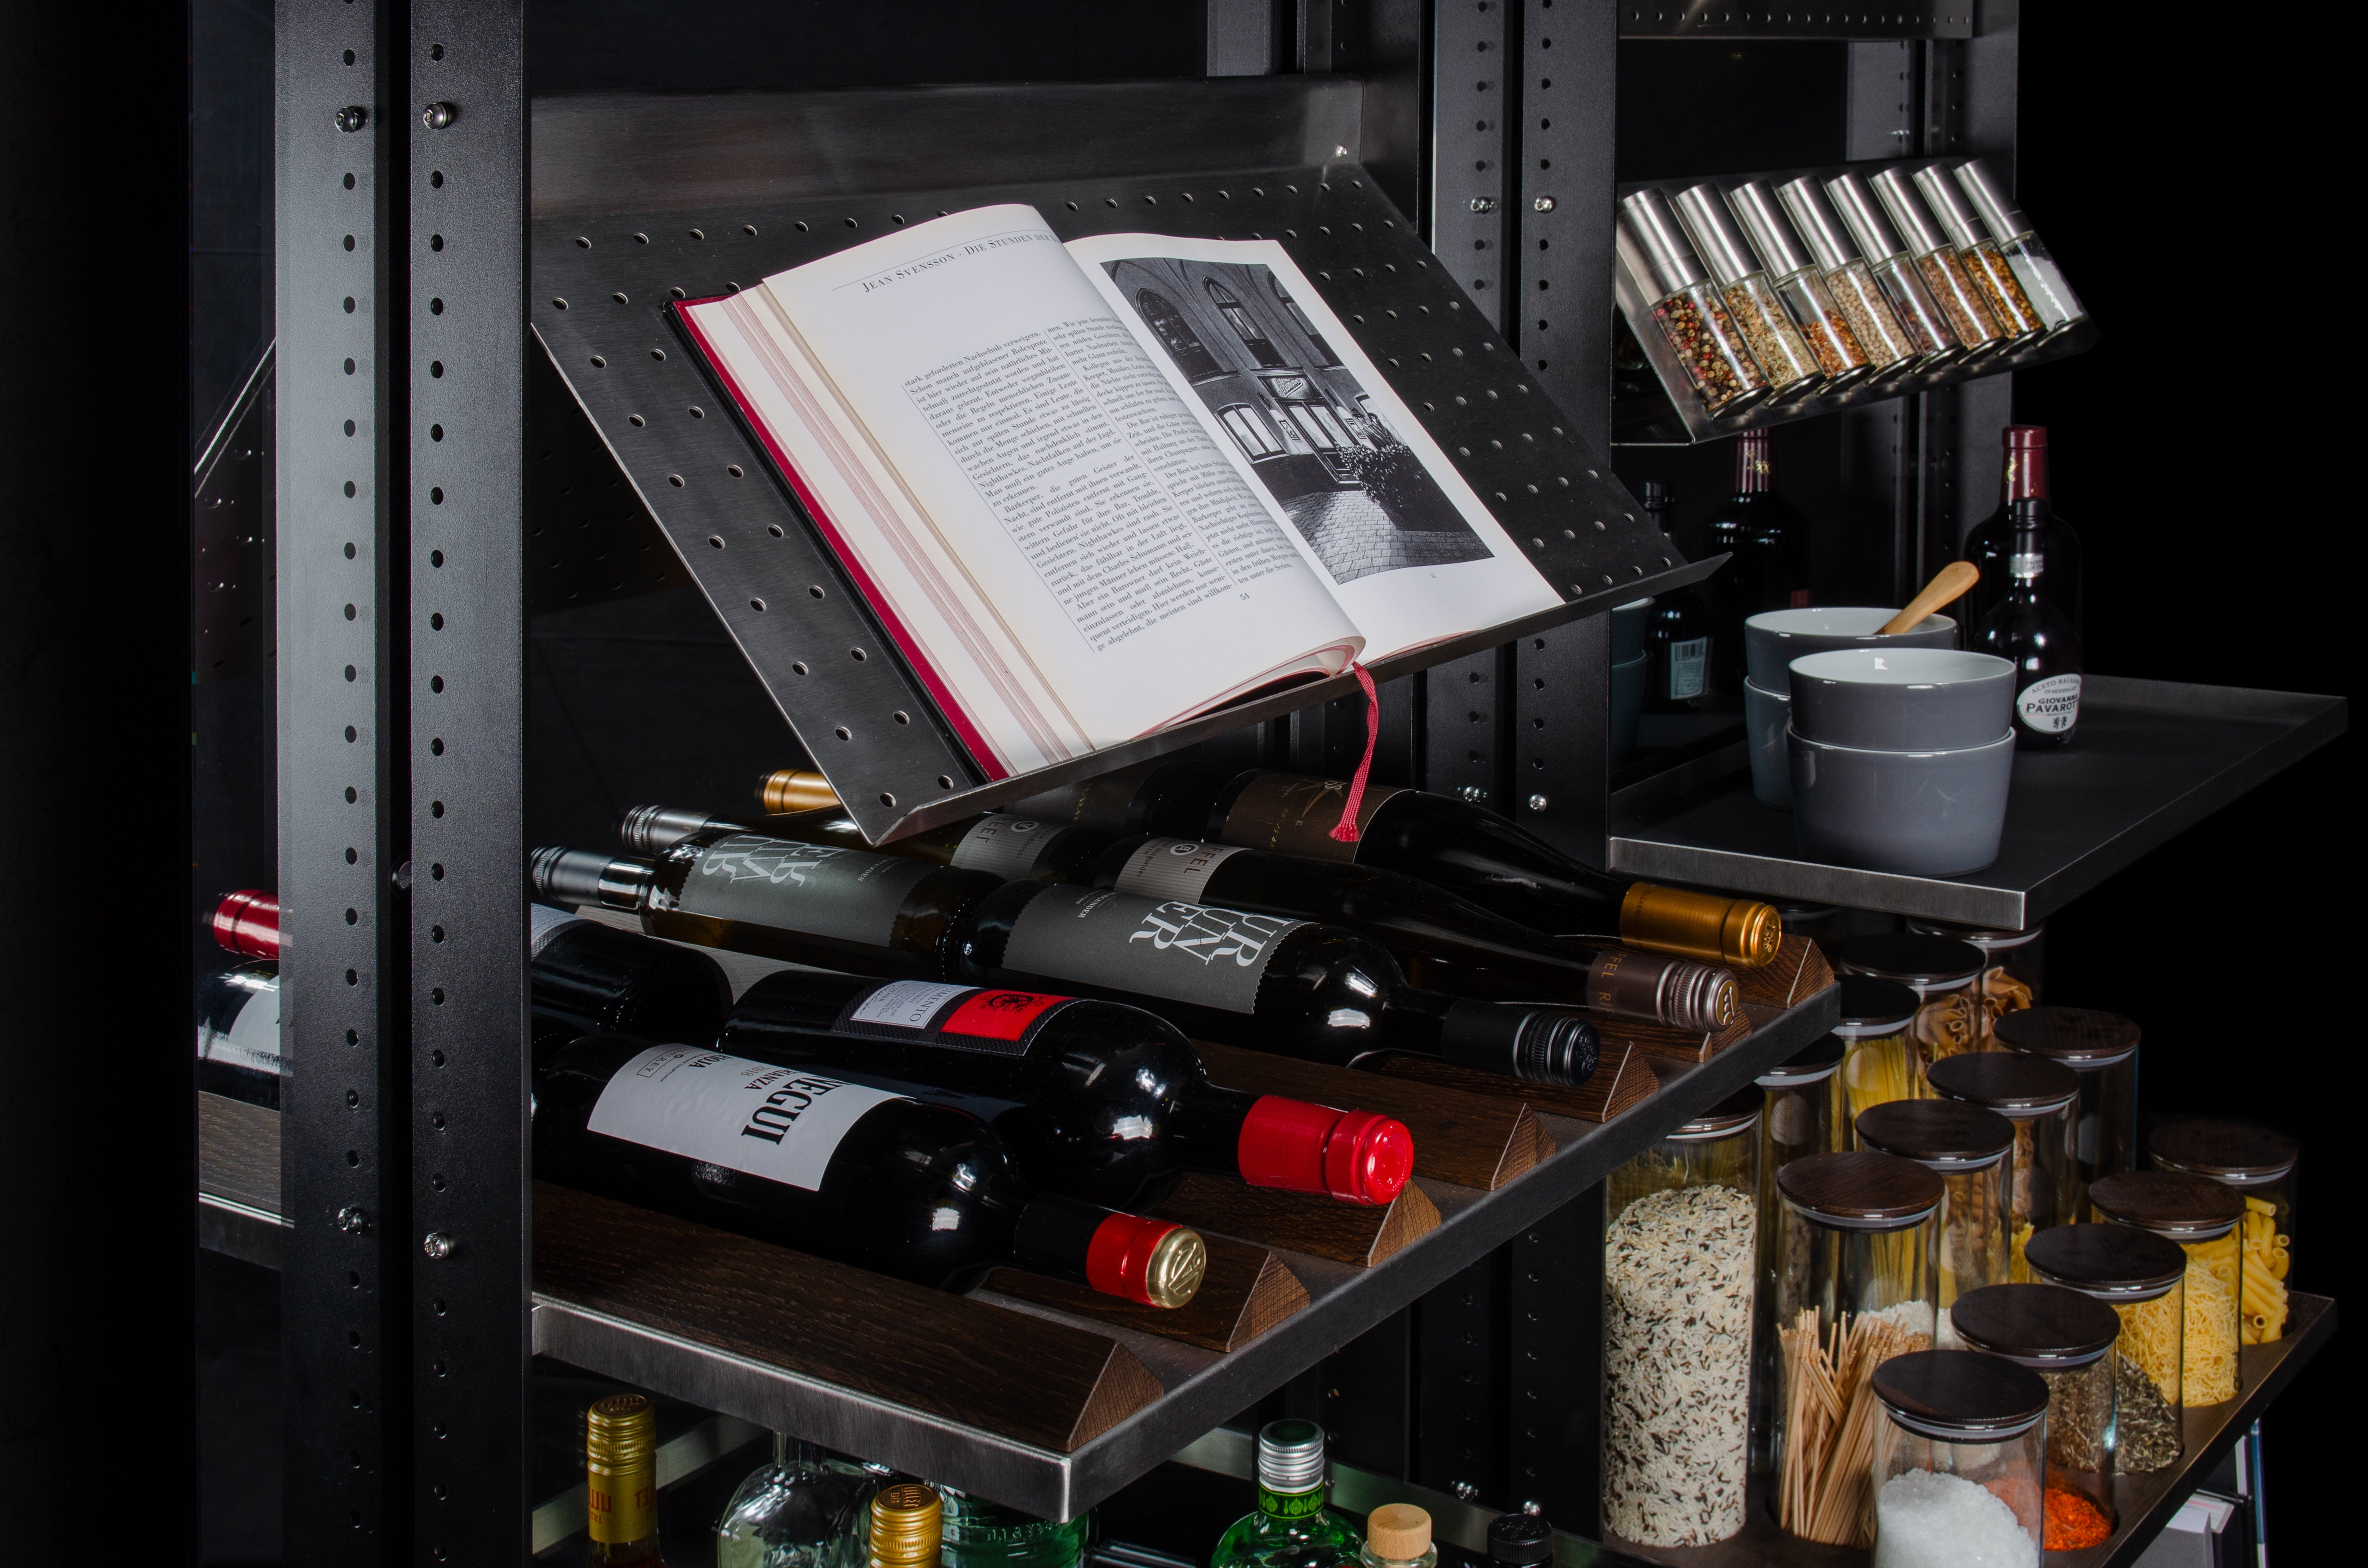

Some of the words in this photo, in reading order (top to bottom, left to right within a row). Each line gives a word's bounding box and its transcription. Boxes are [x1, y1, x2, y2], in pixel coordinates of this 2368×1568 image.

[862, 275, 894, 293] JEAN
[895, 253, 956, 280] SVENSSON
[964, 243, 987, 255] DIE
[987, 234, 1033, 248] STUNDEN
[904, 375, 923, 387] stark
[924, 360, 964, 381] geforderten
[962, 343, 1002, 363] Nachschub
[1002, 332, 1041, 347] verweigern.
[909, 383, 933, 395] Schon
[935, 371, 960, 385] manch
[962, 353, 1010, 375] aufgeblasener
[1010, 339, 1048, 355] Rolexprotz
[922, 397, 949, 412] telmaß
[950, 376, 1002, 401] zurechtgestutzt
[1003, 366, 1030, 379] worden
[1031, 358, 1046, 368] und
[1046, 355, 1060, 363] hat
[925, 390, 942, 399] hier
[944, 379, 968, 392] wieder
[970, 372, 983, 382] auf
[984, 368, 999, 377] sein
[999, 353, 1038, 370] natürliches
[1037, 347, 1053, 356] Mit-
[1071, 355, 1088, 365] mehr
[1081, 360, 1110, 371] Kollegen
[929, 407, 954, 420] daraus
[956, 395, 983, 411] gelernt.
[983, 380, 1019, 397] Entweder
[1020, 364, 1066, 383] wegzubleiben
[1102, 393, 1125, 406] schnell
[1114, 407, 1158, 422] festzuwachsen.
[1125, 420, 1139, 429] Die
[1126, 430, 1144, 439] Zeit,
[1143, 425, 1157, 434] und
[977, 466, 1028, 490] Nighthawkes.
[1026, 447, 1072, 468] Nachtfalken
[1072, 439, 1085, 450] auf
[1085, 436, 1097, 444] der
[1096, 428, 1116, 440] Jagd.
[1153, 458, 1188, 472] verschütten.
[1175, 466, 1191, 475] Rest
[1002, 493, 1044, 514] Barkeeper,
[1049, 485, 1061, 493] die
[1068, 474, 1088, 487] guten
[1093, 461, 1118, 474] Geister
[1002, 485, 1038, 502] erkennen.
[1024, 536, 1050, 551] wittern
[1052, 523, 1078, 538] Gefahr
[1081, 516, 1093, 525] für
[1095, 509, 1111, 518] ihre
[1113, 501, 1131, 511] Bar,
[1131, 488, 1161, 502] Trouble,
[1036, 548, 1077, 568] Gesichtern.
[1077, 526, 1124, 550] Nighthawkes
[1125, 516, 1141, 529] sind
[1142, 510, 1161, 521] rauh.
[1161, 504, 1173, 513] Sie
[1056, 583, 1073, 596] und
[1072, 578, 1086, 588] mit
[1086, 571, 1103, 582] dem
[1102, 559, 1130, 574] Charles
[1129, 542, 1167, 562] Schumann
[1166, 534, 1182, 545] und
[1181, 530, 1193, 539] sei-
[1072, 585, 1099, 602] jungen
[1098, 572, 1127, 588] Männer
[1126, 563, 1148, 575] leben
[1147, 550, 1176, 565] müssen:
[1174, 541, 1194, 553] Haß.
[1248, 570, 1265, 579] unter
[1251, 557, 1271, 567] frühen
[1083, 610, 1124, 632] einzulassen
[1129, 599, 1146, 610] oder
[1152, 578, 1194, 600] abzulehnen,
[1196, 566, 1219, 578] konse-
[1096, 643, 1106, 652] ge
[1107, 624, 1145, 645] abgelehnt,
[1146, 617, 1158, 626] die
[1159, 604, 1186, 620] meisten
[1186, 594, 1203, 607] sind
[1203, 584, 1232, 599] willkom-
[1240, 592, 1250, 600] 54
